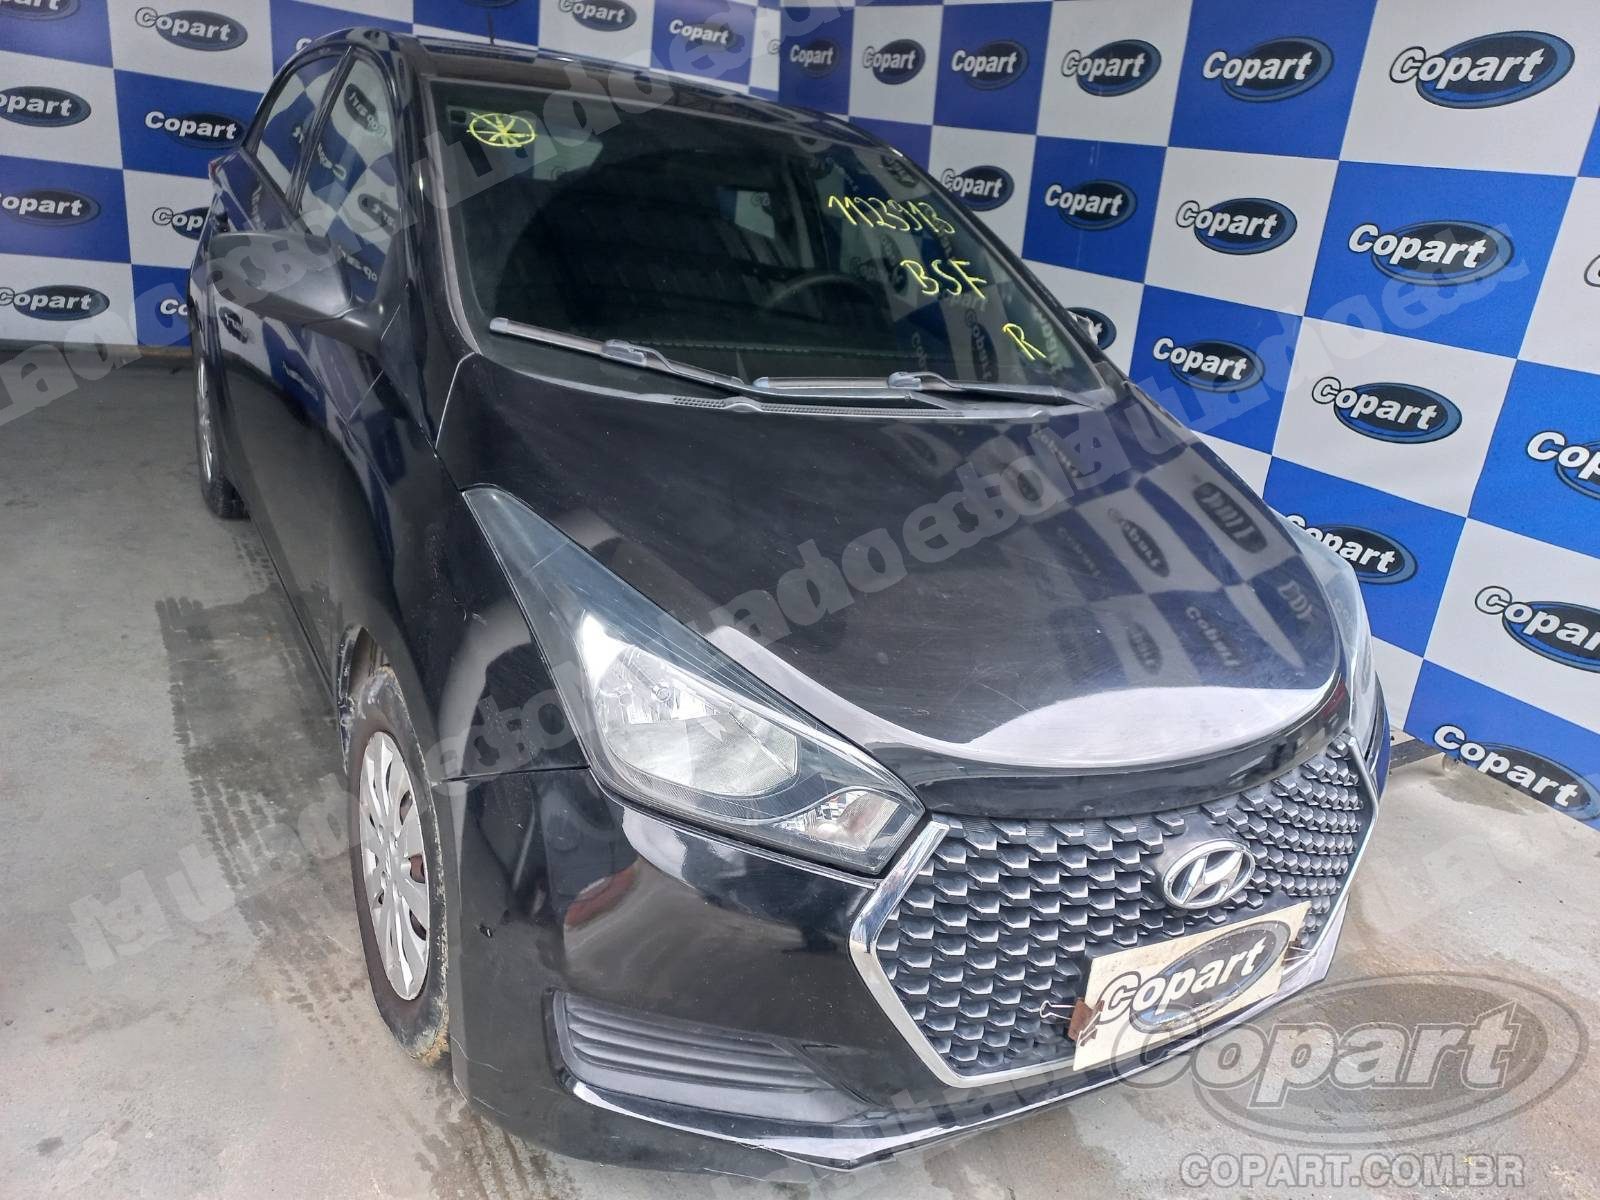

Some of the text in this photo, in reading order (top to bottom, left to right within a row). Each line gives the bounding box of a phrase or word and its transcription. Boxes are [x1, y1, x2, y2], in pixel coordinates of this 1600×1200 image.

[135, 7, 232, 41] Copart
[669, 19, 730, 45] Copart
[790, 45, 834, 65] Copart
[862, 46, 917, 70] Copart
[951, 49, 1019, 77] Copart
[1061, 49, 1146, 82] Copart
[1202, 50, 1314, 87] Copart
[1389, 46, 1546, 90] Copart
[145, 111, 238, 139] Copart
[940, 168, 1003, 198] Copart
[1044, 183, 1124, 217] Copart
[1176, 200, 1278, 239] Copart
[1348, 223, 1487, 269] Copart
[1002, 322, 1046, 361] R
[1152, 337, 1248, 381] Copart
[1311, 376, 1438, 430] Copart
[1433, 724, 1579, 807] Copart
[1094, 935, 1266, 1025] Copart
